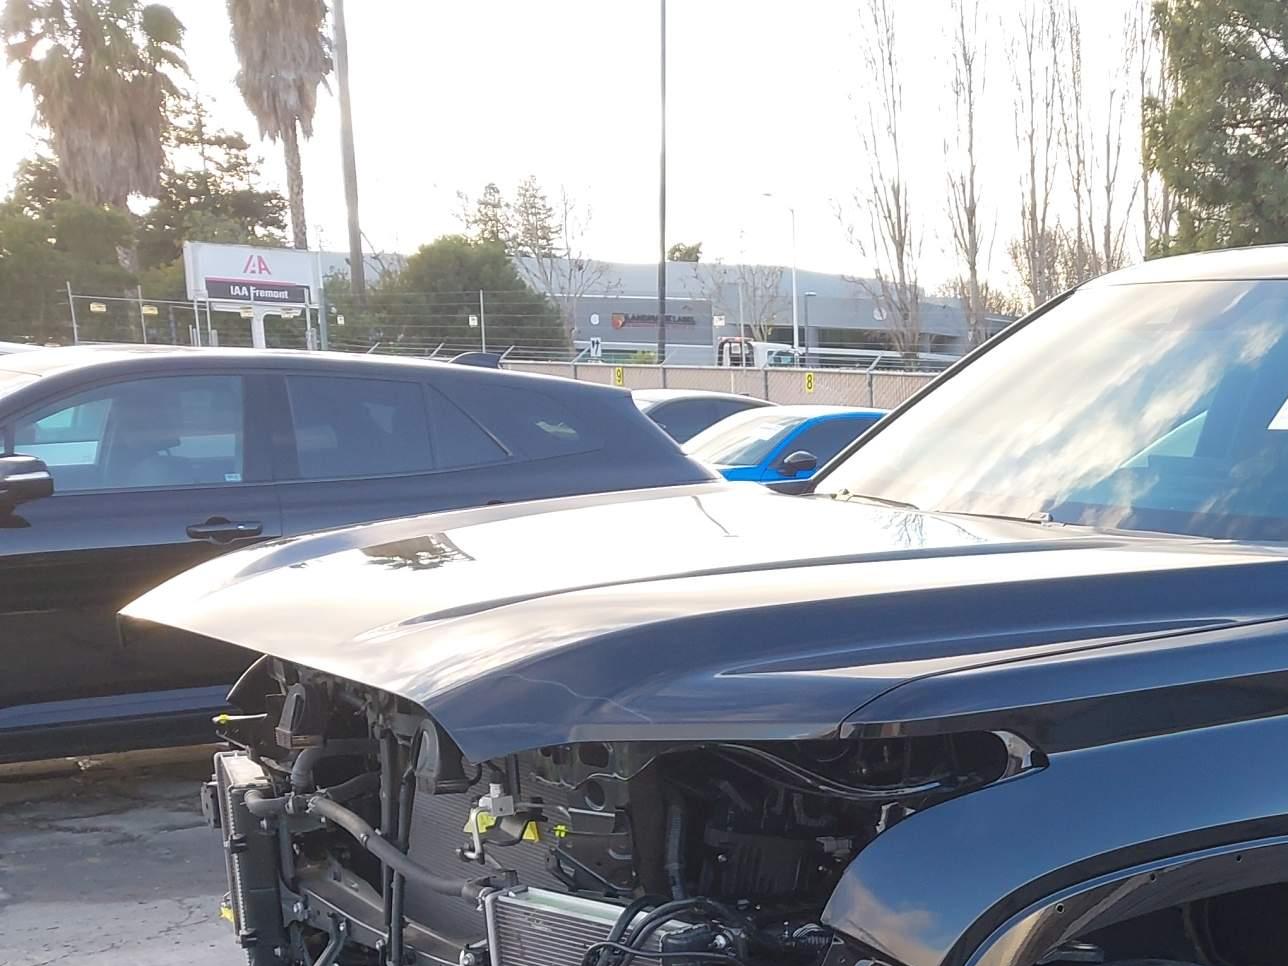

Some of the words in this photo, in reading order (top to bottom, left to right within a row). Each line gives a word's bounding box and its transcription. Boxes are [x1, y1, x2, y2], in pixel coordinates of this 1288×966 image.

[230, 285, 249, 297] IAA
[251, 286, 289, 299] Fremont
[616, 369, 622, 383] 9
[806, 374, 813, 390] 8
